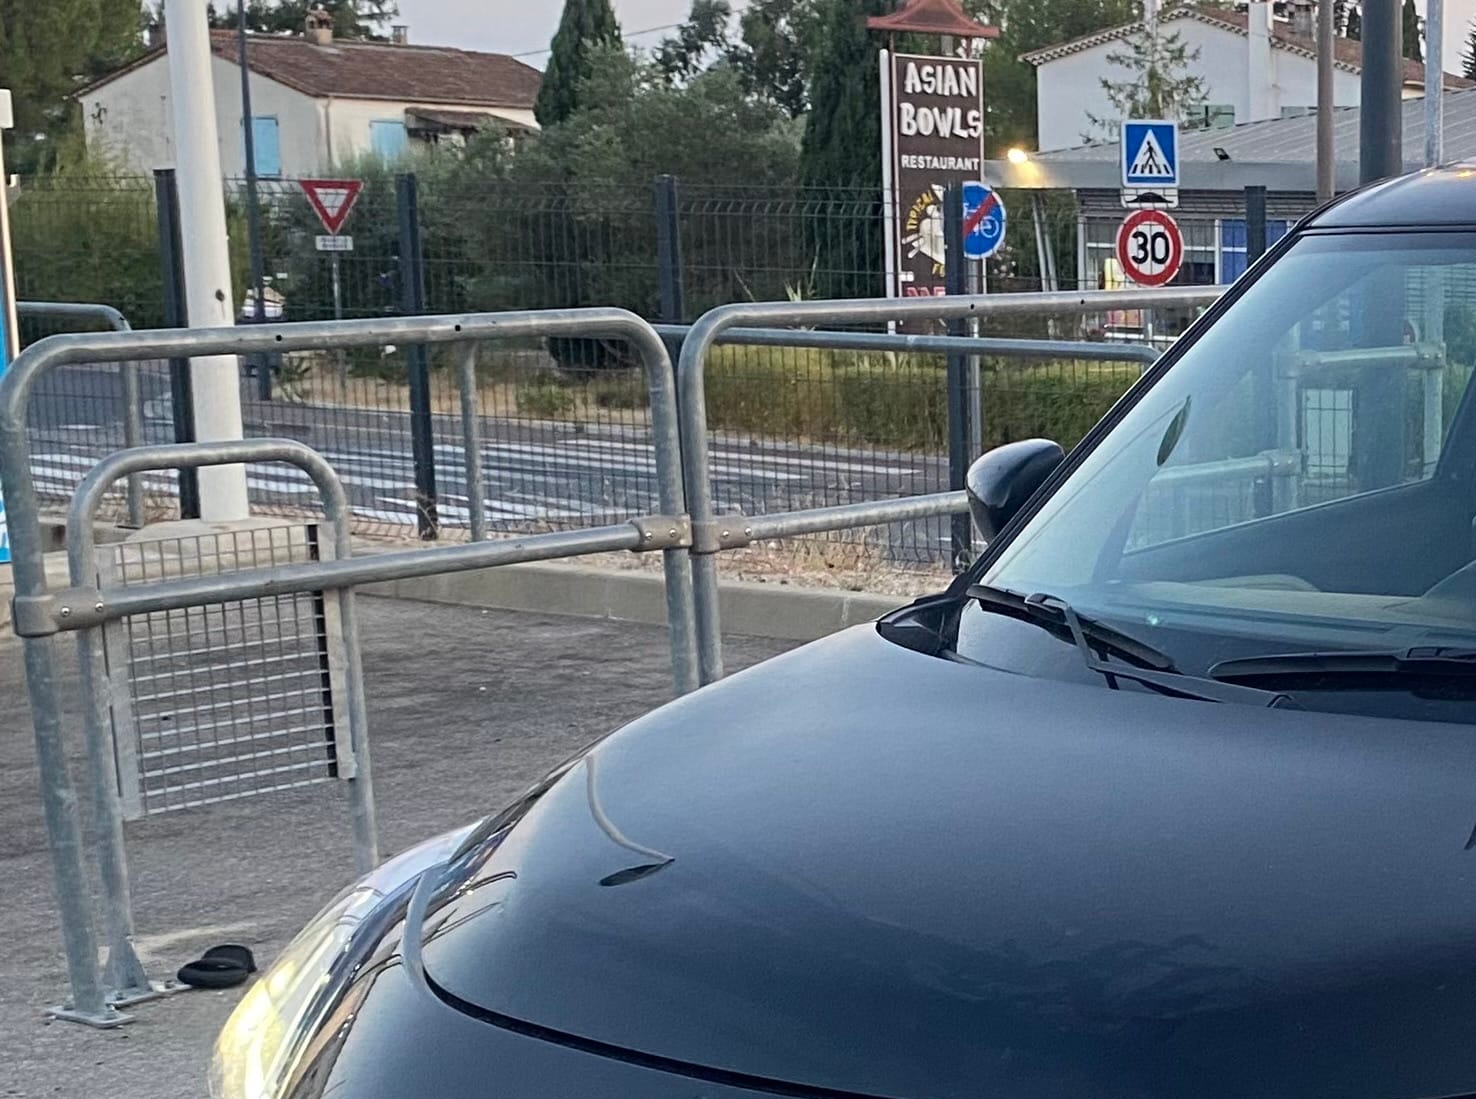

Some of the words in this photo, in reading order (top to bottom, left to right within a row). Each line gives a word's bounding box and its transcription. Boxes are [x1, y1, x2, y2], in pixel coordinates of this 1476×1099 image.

[904, 62, 977, 97] ASIAN
[900, 102, 981, 138] BOWLS
[901, 155, 979, 170] RESTAURANT
[1131, 231, 1170, 264] 30
